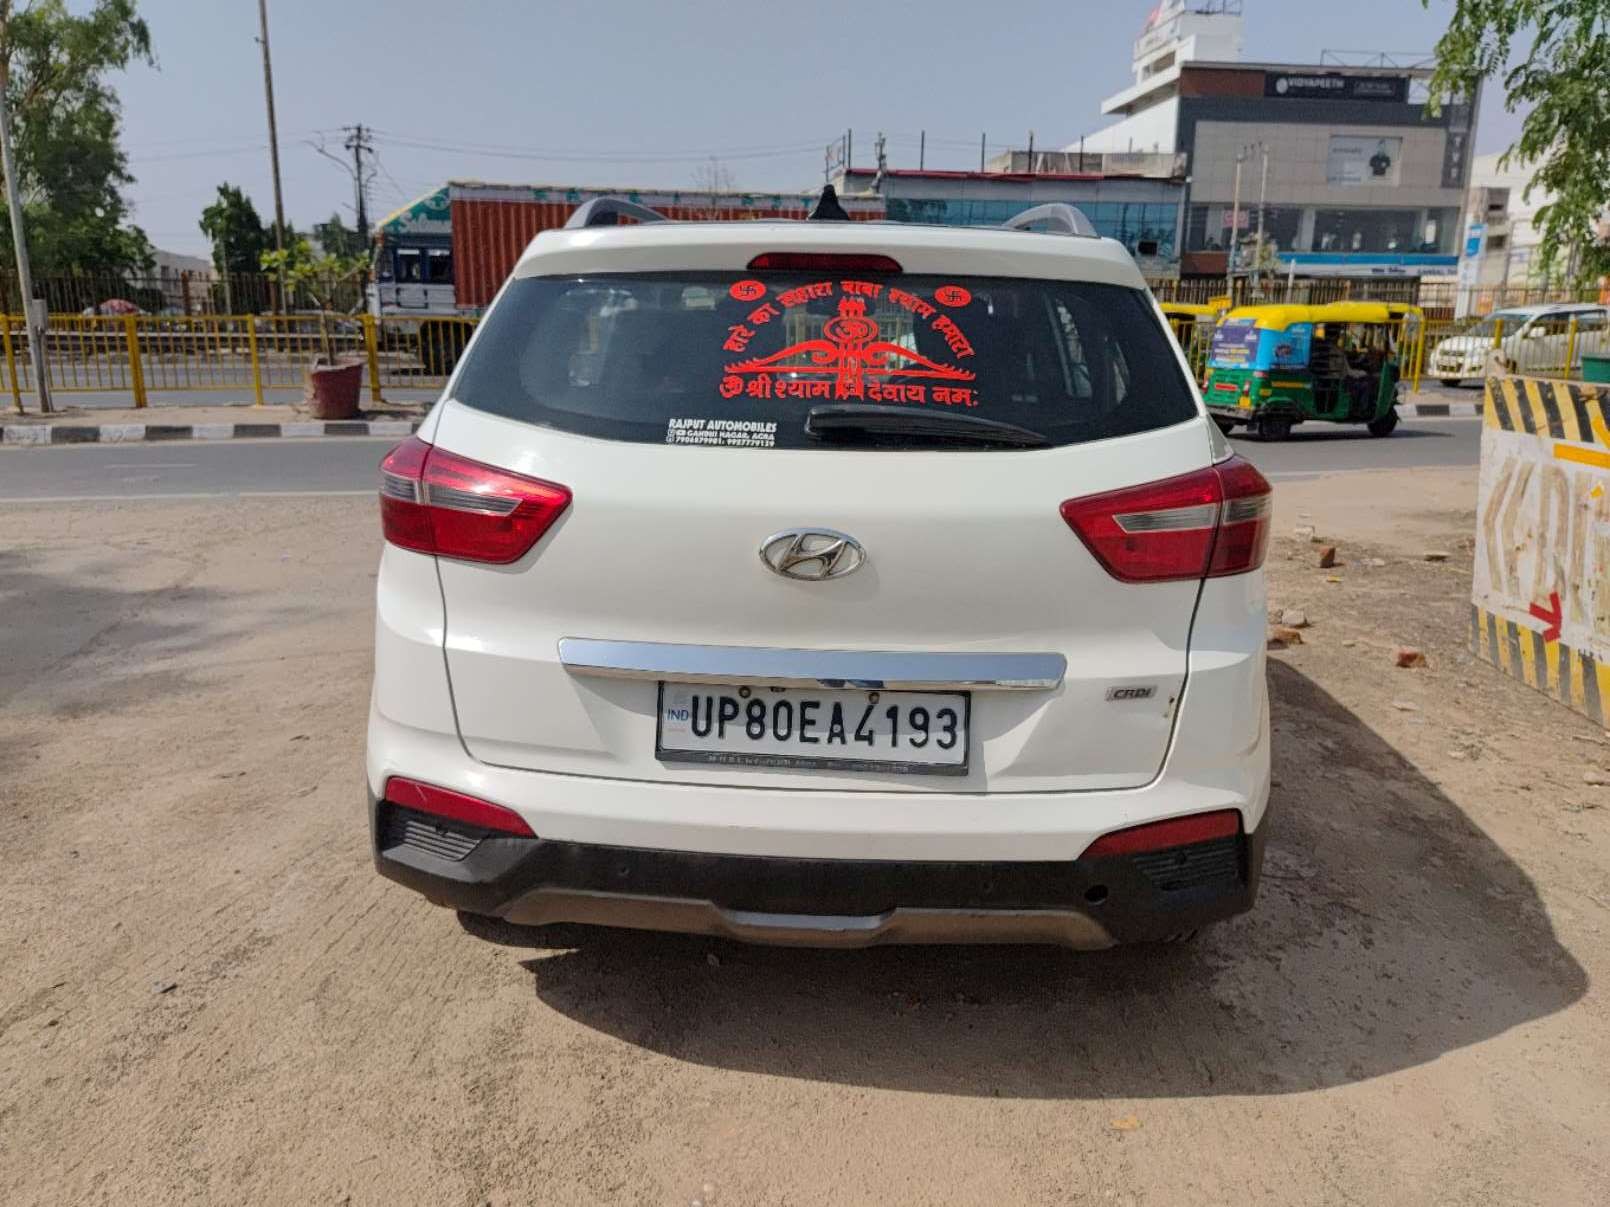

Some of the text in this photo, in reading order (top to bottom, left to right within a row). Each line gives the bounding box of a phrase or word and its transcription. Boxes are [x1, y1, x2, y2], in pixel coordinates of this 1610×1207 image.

[747, 302, 780, 325] का
[776, 281, 833, 307] सहारा
[840, 280, 883, 299] बाबा
[931, 314, 975, 359] हमारा
[774, 379, 831, 399] श्याम
[866, 380, 926, 403] देवाय
[669, 418, 777, 433] RAJPUT AUTOMOBILES
[666, 695, 958, 750] IND UP80EA4193
